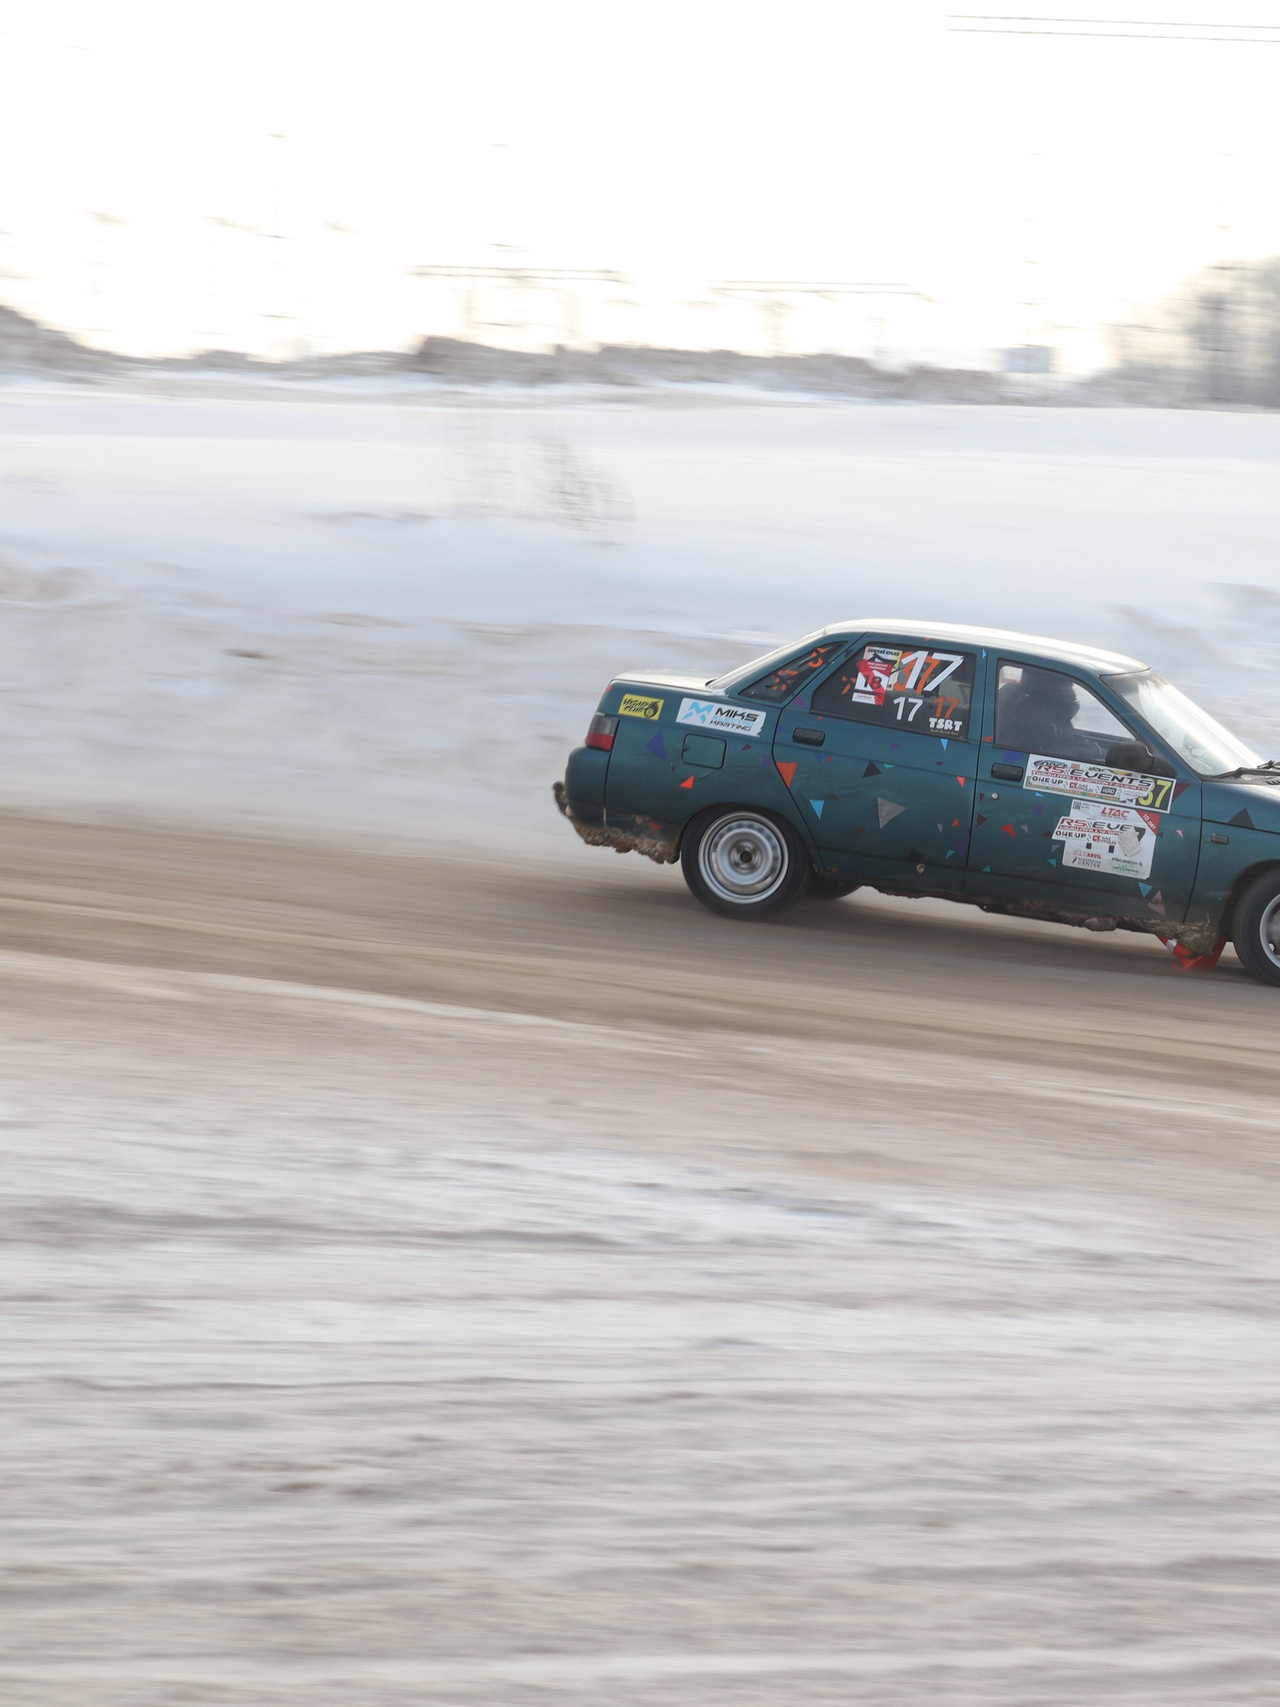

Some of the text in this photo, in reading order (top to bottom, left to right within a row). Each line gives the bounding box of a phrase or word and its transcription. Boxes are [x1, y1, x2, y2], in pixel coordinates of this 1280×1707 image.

[901, 650, 964, 692] 17
[715, 707, 760, 722] MIKS
[893, 697, 924, 721] 17
[934, 696, 959, 718] 17
[710, 720, 752, 732] KARTING
[929, 717, 962, 731] TSRT
[1069, 768, 1152, 787] EVENTS
[1101, 806, 1130, 818] LTAC
[1060, 817, 1087, 827] RS
